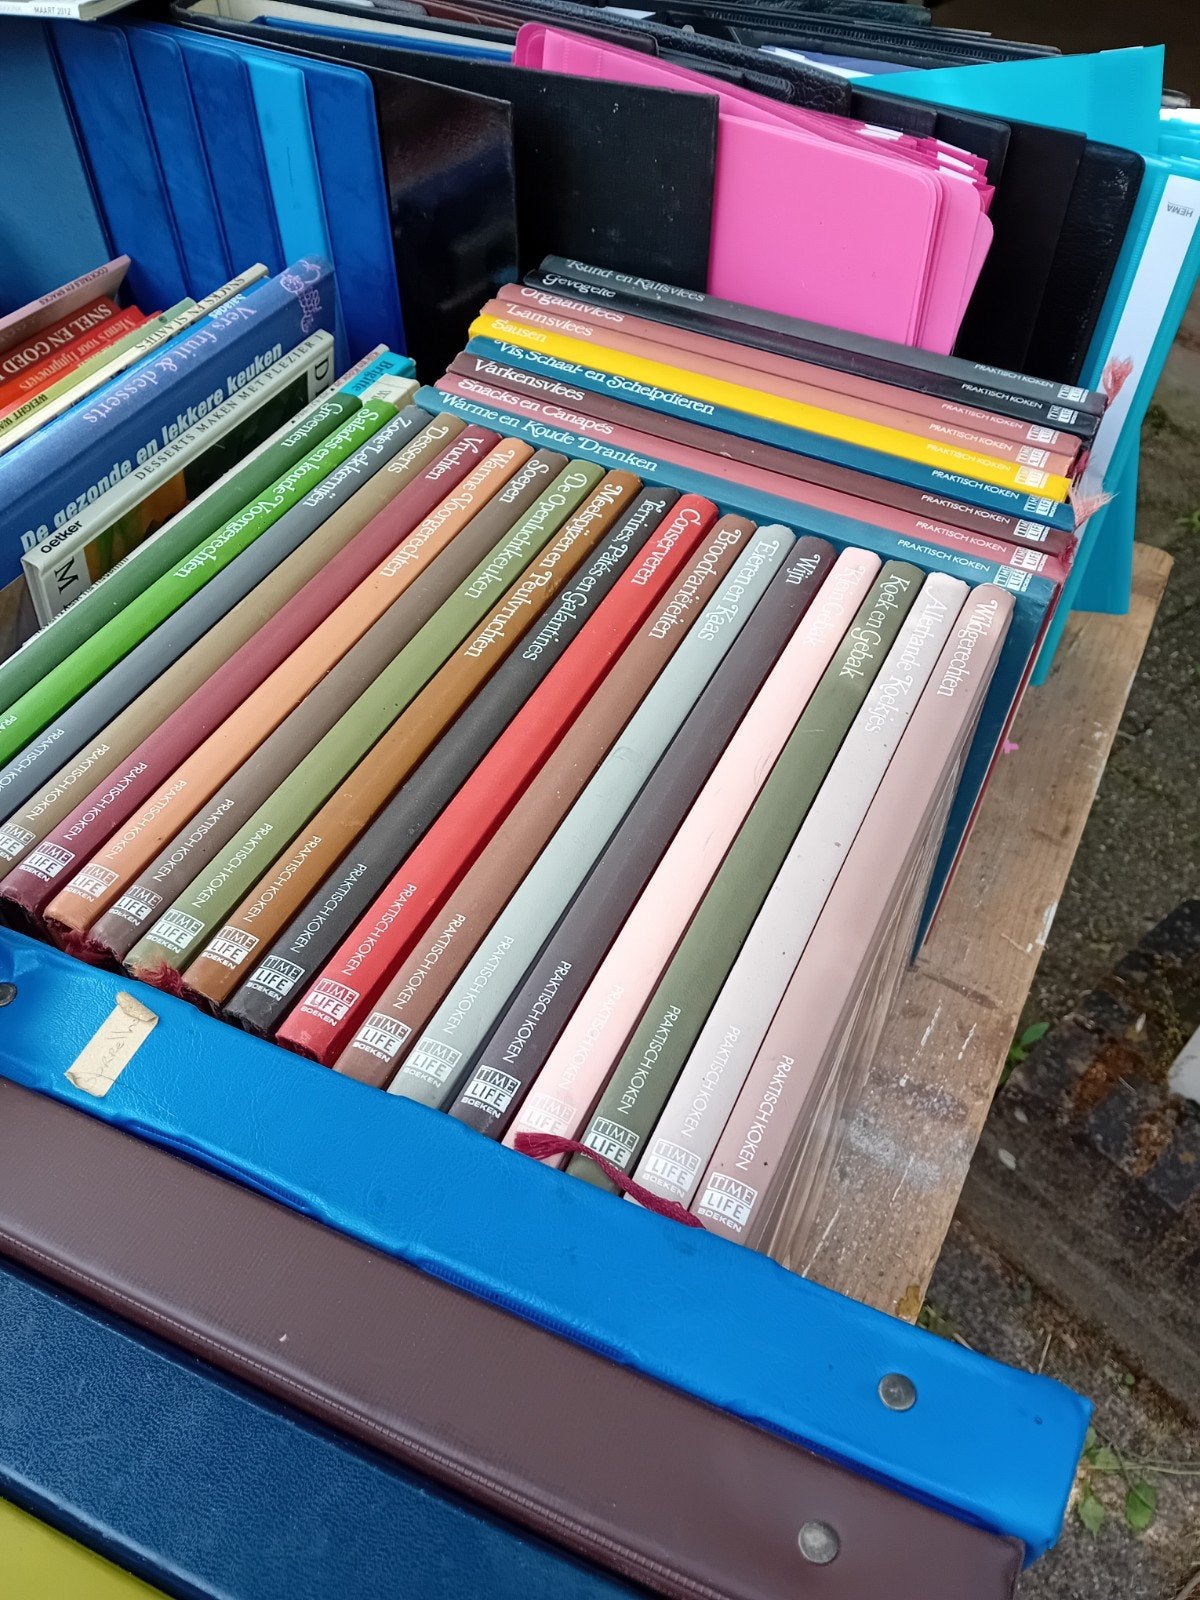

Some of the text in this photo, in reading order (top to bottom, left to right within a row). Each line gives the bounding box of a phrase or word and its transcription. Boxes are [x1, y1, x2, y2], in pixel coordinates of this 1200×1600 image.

[1166, 202, 1194, 218] HEMA
[616, 273, 632, 283] en
[69, 303, 113, 332] SNEL
[506, 303, 594, 337] Lamsvlees
[520, 287, 625, 323] Orgaanvlees
[47, 331, 75, 348] EN
[79, 337, 100, 352] voor
[491, 319, 548, 343] Sausen
[3, 341, 51, 374] GOED
[82, 306, 258, 424] Vers fruit & desserts
[352, 360, 395, 391] Brigitte
[474, 359, 586, 401] Varkensvlees
[494, 340, 524, 360] Vis,
[585, 366, 605, 380] en
[605, 375, 715, 416] Schelpdieren
[13, 393, 48, 420] WEIGHT
[134, 433, 197, 481] DESSERTS
[197, 400, 239, 433] MAKEN
[238, 379, 265, 401] MET
[264, 341, 315, 379] PLEZIER
[458, 378, 615, 436] Snacks en Canapés
[961, 383, 1043, 410] PRAKTISCH KOKEN
[281, 402, 345, 447] Groenten
[438, 390, 659, 472] Warme en Koude Dranken
[928, 422, 1013, 452] PRAKTISCH KOKEN
[990, 414, 1024, 430] KOKEN
[20, 525, 49, 553] De
[53, 459, 133, 530] gezonde
[136, 441, 158, 465] en
[161, 387, 225, 446] lekkere
[226, 342, 283, 397] keuken
[302, 416, 413, 508] Zoete Lekkernijen
[387, 425, 449, 474] Desserts
[425, 436, 484, 482] Vruchten
[173, 408, 379, 579] Salades en koude Voorgerechten
[499, 459, 549, 504] Soepen
[931, 470, 1020, 500] PRAKTISCH KOKEN
[379, 449, 515, 578] Warme Voorgerechten
[921, 494, 1011, 525] PRAKTISCH KOKEN
[40, 520, 84, 554] Oetker
[464, 472, 588, 600] De Openluchtkeuken
[630, 507, 701, 587] Conserveren
[915, 520, 1007, 553] PRAKTISCH KOKEN
[539, 551, 561, 568] en
[785, 553, 821, 585] Wijn
[897, 539, 952, 562] PRAKTISCH
[952, 555, 991, 572] KOKEN
[522, 499, 666, 662] Terrines, Pâtés en Galantines
[648, 528, 742, 640] Broodvariëteiten
[697, 540, 780, 642] Eieren en Kaas
[828, 565, 867, 602] Klein
[464, 570, 553, 658] Peulvruchten
[838, 573, 911, 680] Koek en Gebak
[864, 585, 949, 735] Allerhande Koekjes
[936, 600, 998, 698] Wildgerechten
[14, 728, 65, 773] PRAKTISCH
[60, 743, 111, 790] PRAKTISCH
[25, 788, 66, 821] KOKEN
[63, 762, 148, 841] PRAKTISCH KOKEN
[105, 779, 188, 860] PRAKTISCH KOKEN
[38, 842, 73, 864] TIME
[152, 798, 235, 882] PRAKTISCH KOKEN
[27, 855, 56, 877] LIFE
[191, 823, 274, 908] PRAKTISCH KOKEN
[243, 835, 322, 923] PRAKTISCH KOKEN
[71, 876, 101, 897] LIFE
[117, 897, 148, 919] LIFE
[165, 909, 202, 932] TIME
[290, 863, 368, 953] PRAKTISCH KOKEN
[153, 923, 186, 946] LIFE
[220, 927, 257, 950] TIME
[341, 883, 418, 977] PRAKTISCH KOKEN
[209, 940, 241, 962] LIFE
[393, 913, 466, 1010] PRAKTISCH KOKEN
[254, 970, 288, 993] LIFE
[265, 956, 303, 980] TIME
[246, 982, 283, 1001] BOEKEN
[316, 980, 358, 1006] TIME
[443, 935, 515, 1035] PRAKTISCH KOKEN
[300, 1006, 338, 1027] BOEKEN
[308, 992, 343, 1017] LIFE
[502, 960, 572, 1063] PRAKTISCH KOKEN
[360, 1028, 395, 1053] LIFE
[369, 1014, 410, 1039] TIME
[352, 1041, 391, 1063] BOEKEN
[409, 1053, 447, 1080] LIFE
[617, 1004, 682, 1115] PRAKTISCH KOKEN
[470, 1081, 507, 1109] LIFE
[478, 1066, 520, 1094] TIME
[681, 1024, 741, 1139] PRAKTISCH KOKEN
[461, 1097, 502, 1118] BOEKEN
[735, 1054, 795, 1172] PRAKTISCH KOKEN
[589, 1134, 627, 1164] LIFE
[597, 1119, 637, 1150] TIME
[650, 1158, 688, 1187] LIFE
[706, 1192, 746, 1222] LIFE
[712, 1176, 756, 1208] TIME
[697, 1205, 742, 1233] BOEKEN
